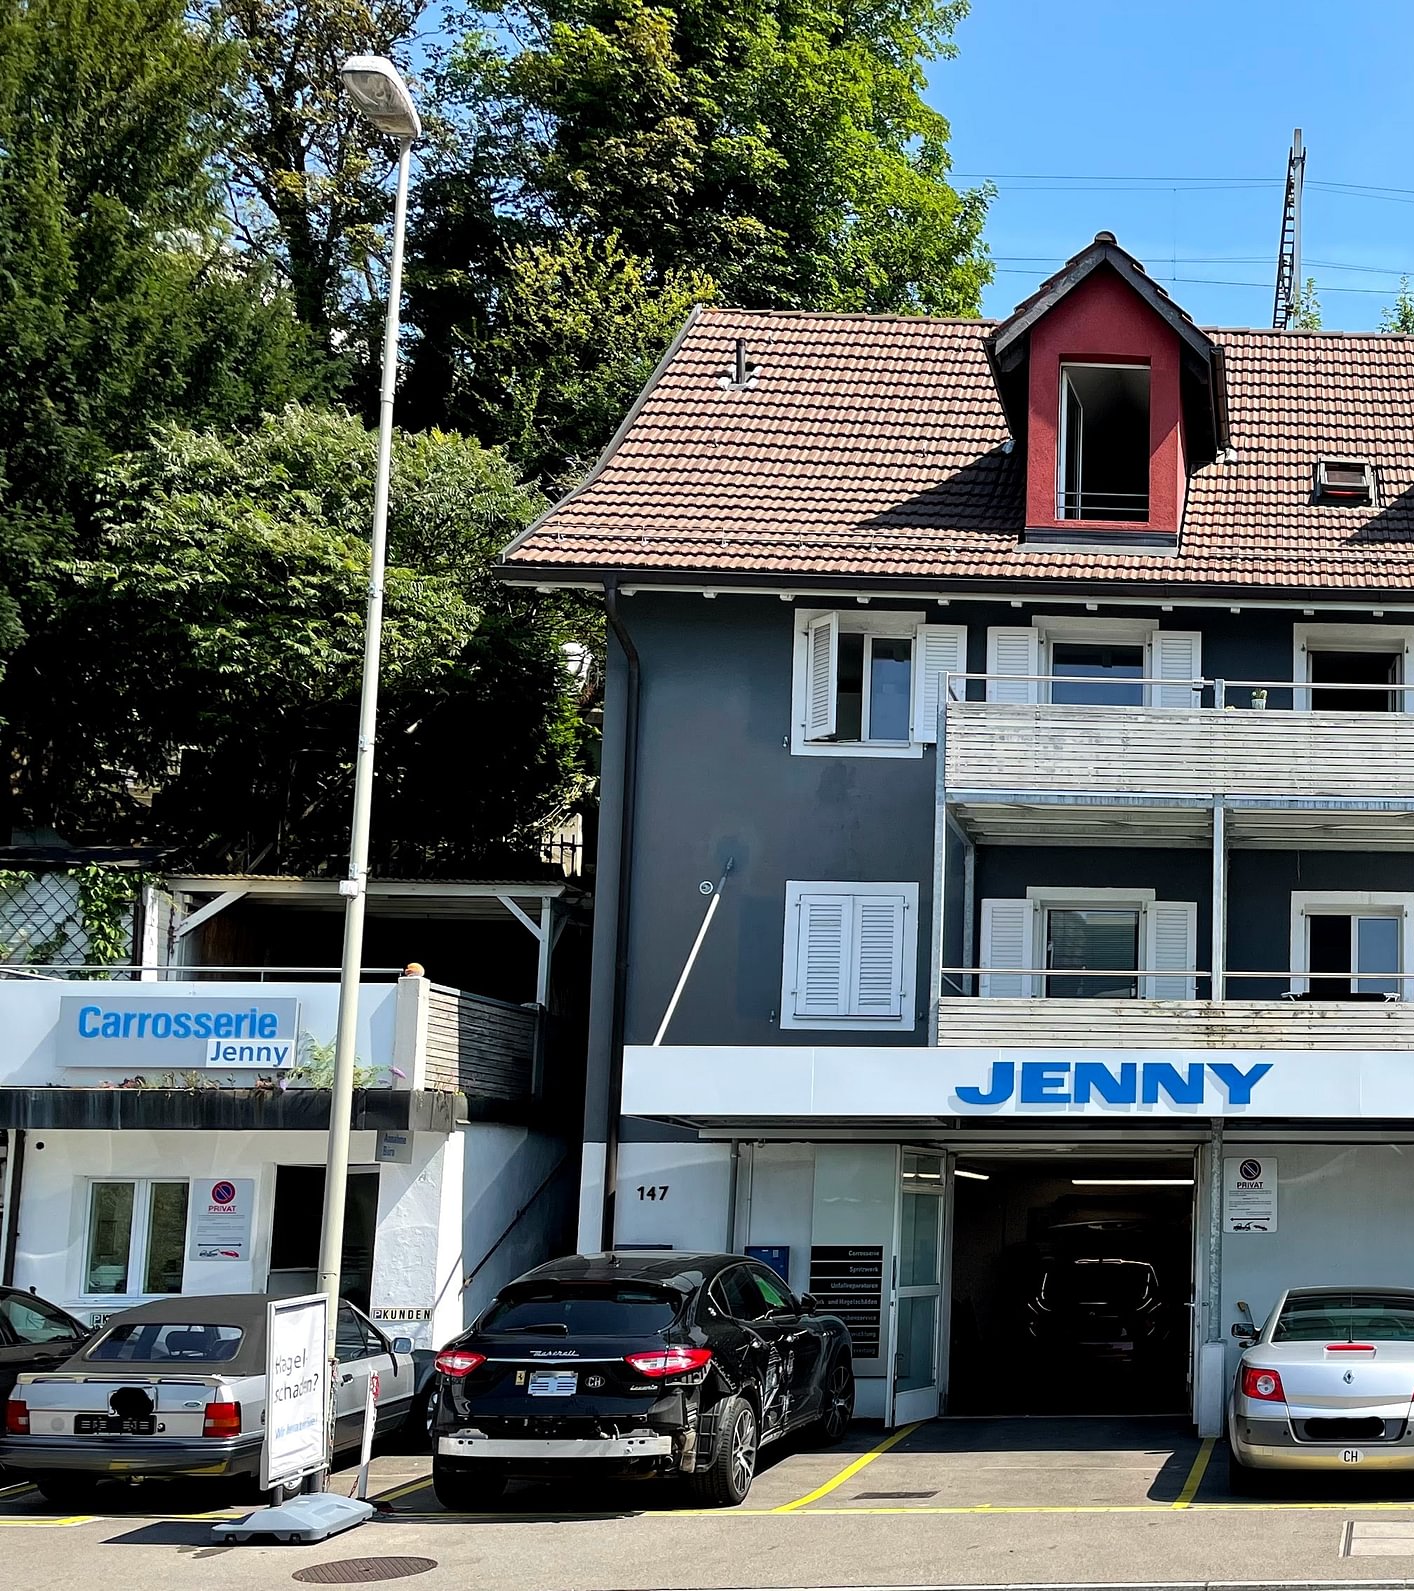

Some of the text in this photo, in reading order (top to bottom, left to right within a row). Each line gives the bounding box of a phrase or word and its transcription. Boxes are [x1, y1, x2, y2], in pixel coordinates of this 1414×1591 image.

[78, 1005, 278, 1039] Carrosserie
[210, 1041, 289, 1068] Jenny
[955, 1061, 1274, 1105] JENNY
[636, 1185, 670, 1201] 147
[208, 1205, 237, 1213] PRIVAT
[588, 1377, 601, 1388] CH
[1343, 1450, 1358, 1463] CH
